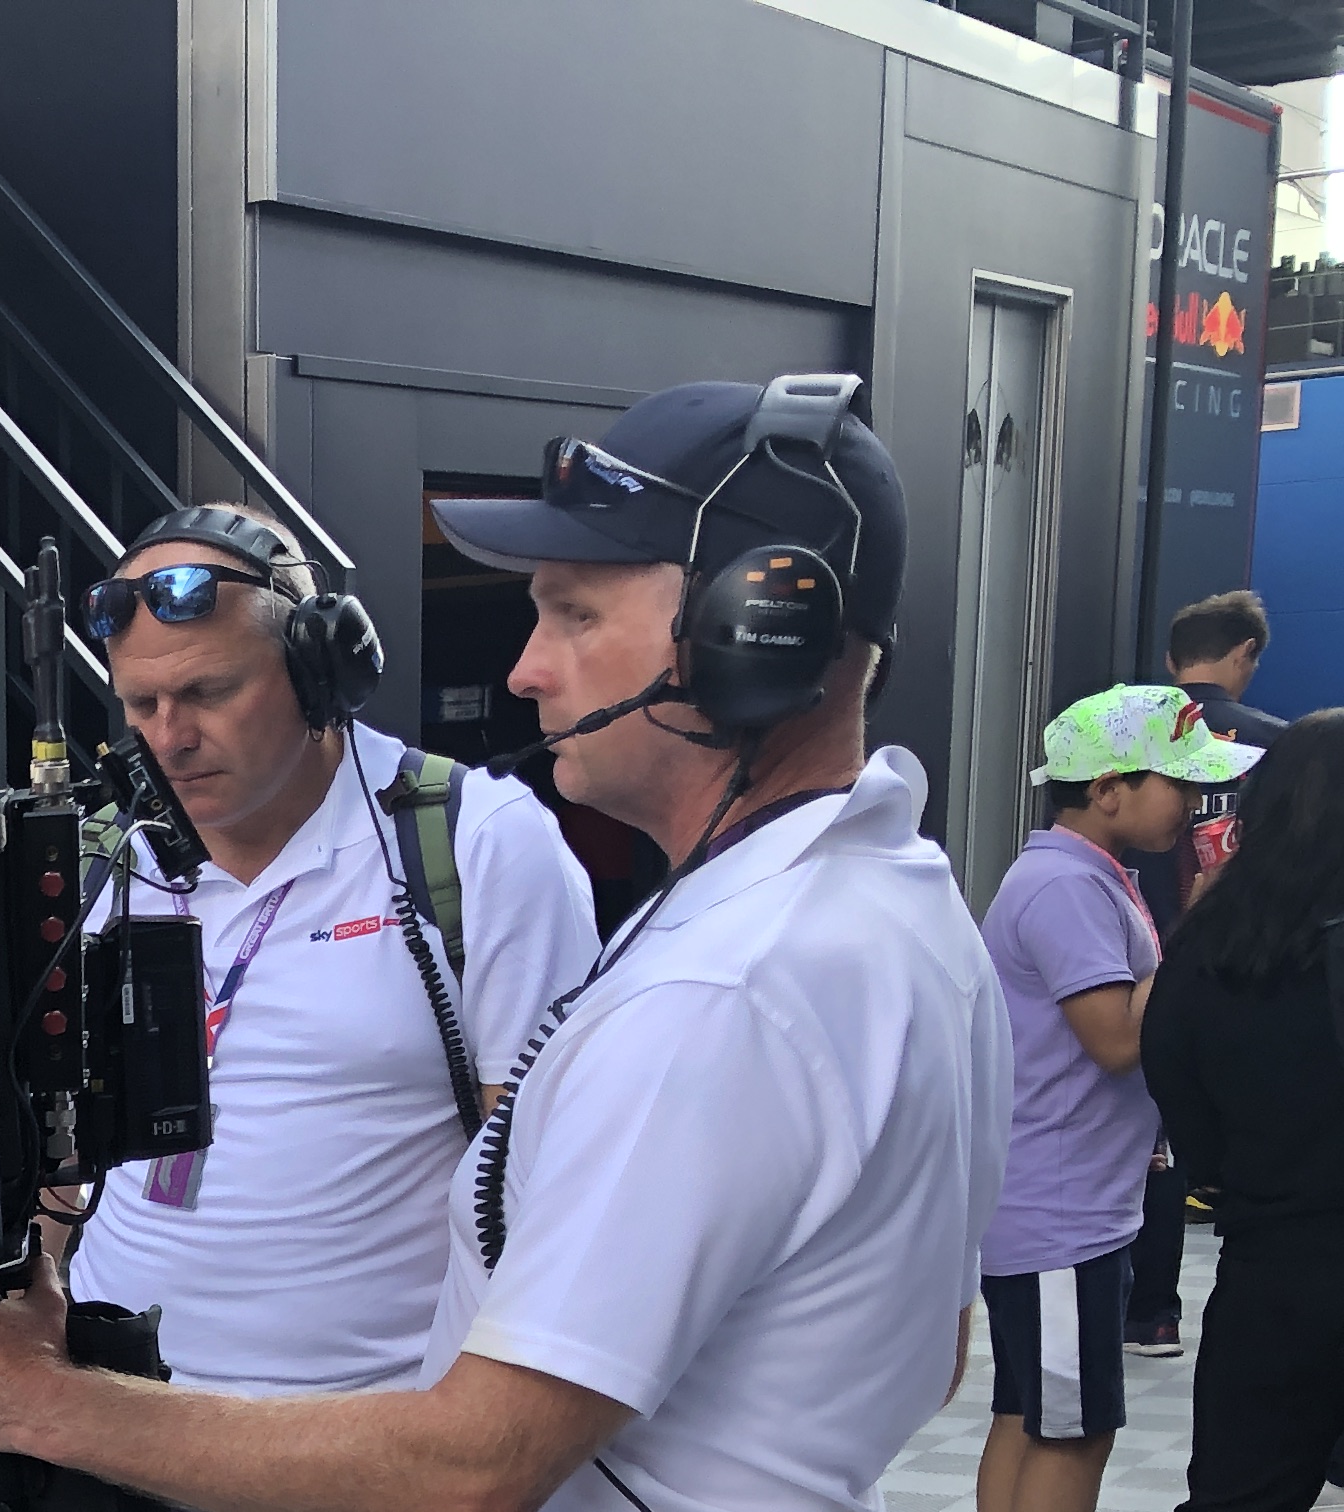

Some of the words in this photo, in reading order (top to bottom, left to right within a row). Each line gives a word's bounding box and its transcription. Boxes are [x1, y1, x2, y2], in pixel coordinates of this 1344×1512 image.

[1150, 202, 1251, 283] OACLE
[1174, 379, 1242, 418] CING
[310, 930, 333, 942] sky
[336, 919, 378, 937] sports
